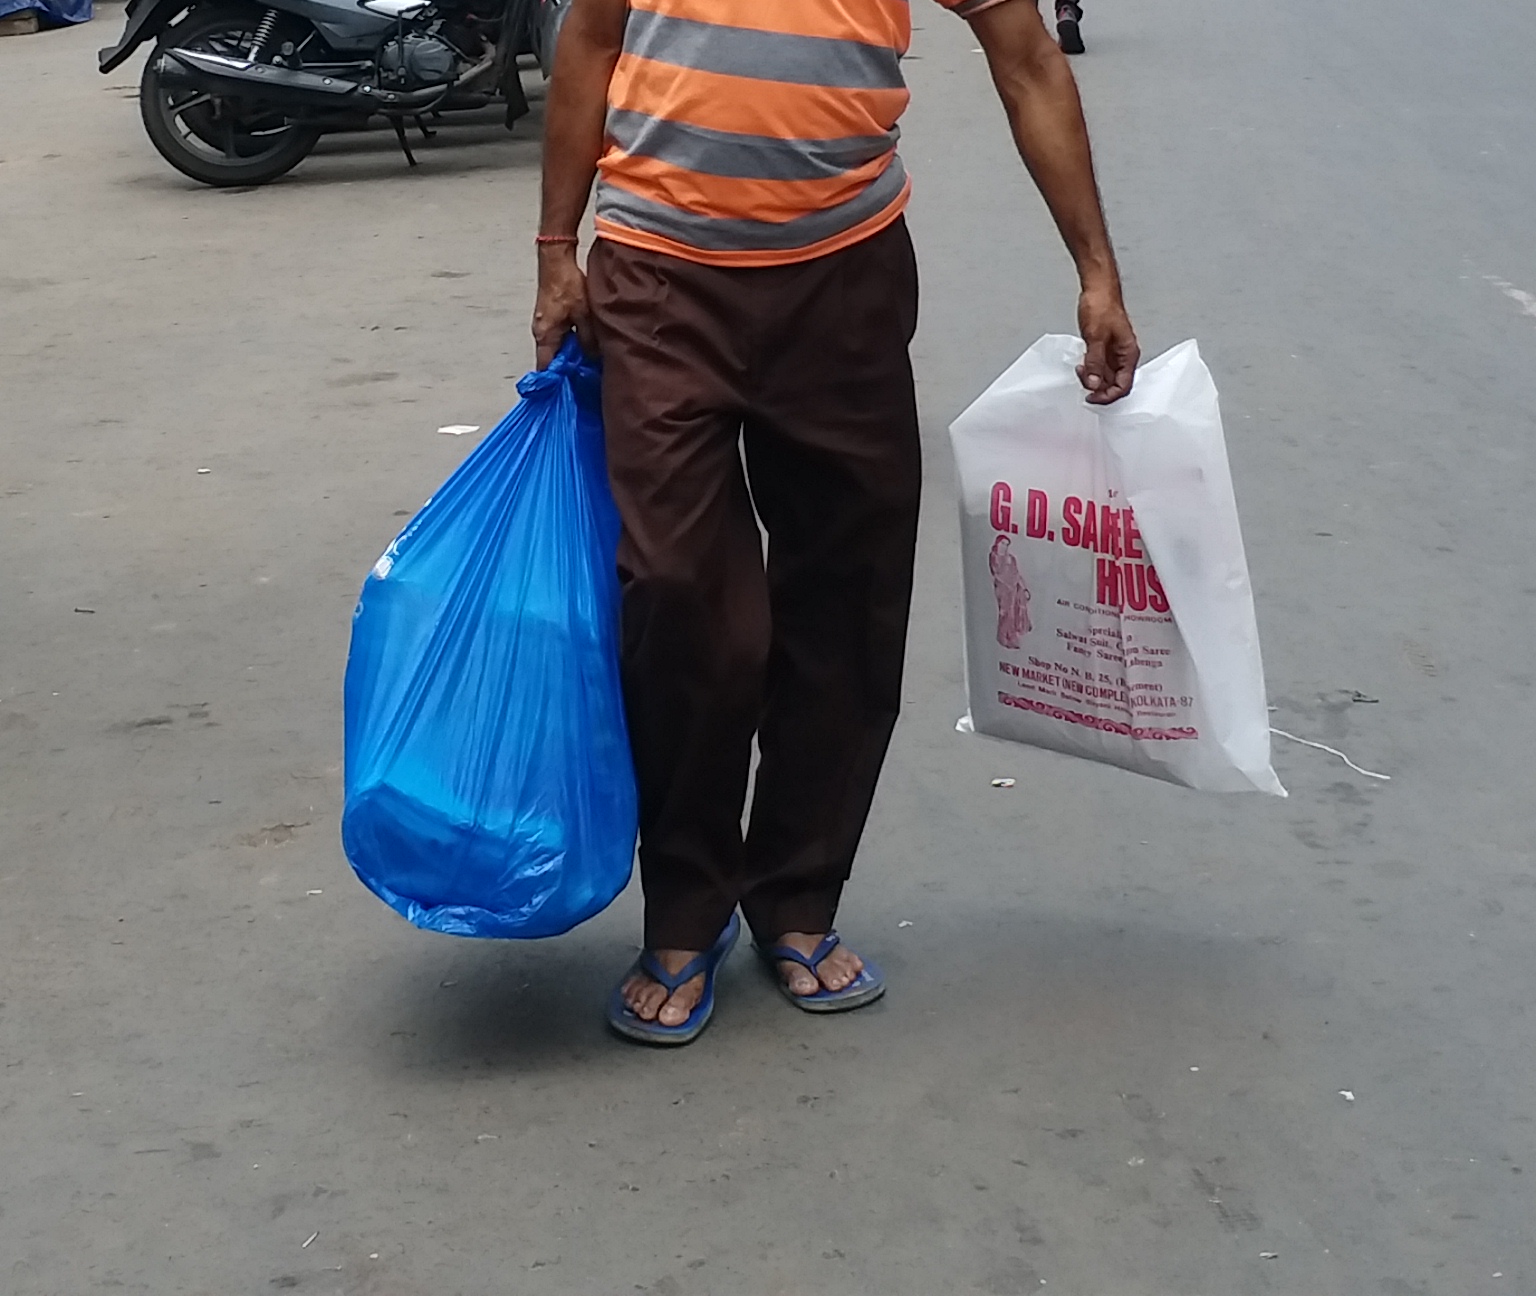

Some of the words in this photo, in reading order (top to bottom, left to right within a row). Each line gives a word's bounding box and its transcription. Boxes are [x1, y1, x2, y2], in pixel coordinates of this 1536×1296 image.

[990, 481, 1018, 534] G.
[1026, 489, 1054, 542] D.
[1056, 598, 1071, 606] AIR
[1028, 656, 1051, 671] Shop
[999, 661, 1020, 678] NEW
[1022, 667, 1060, 688] MARKET
